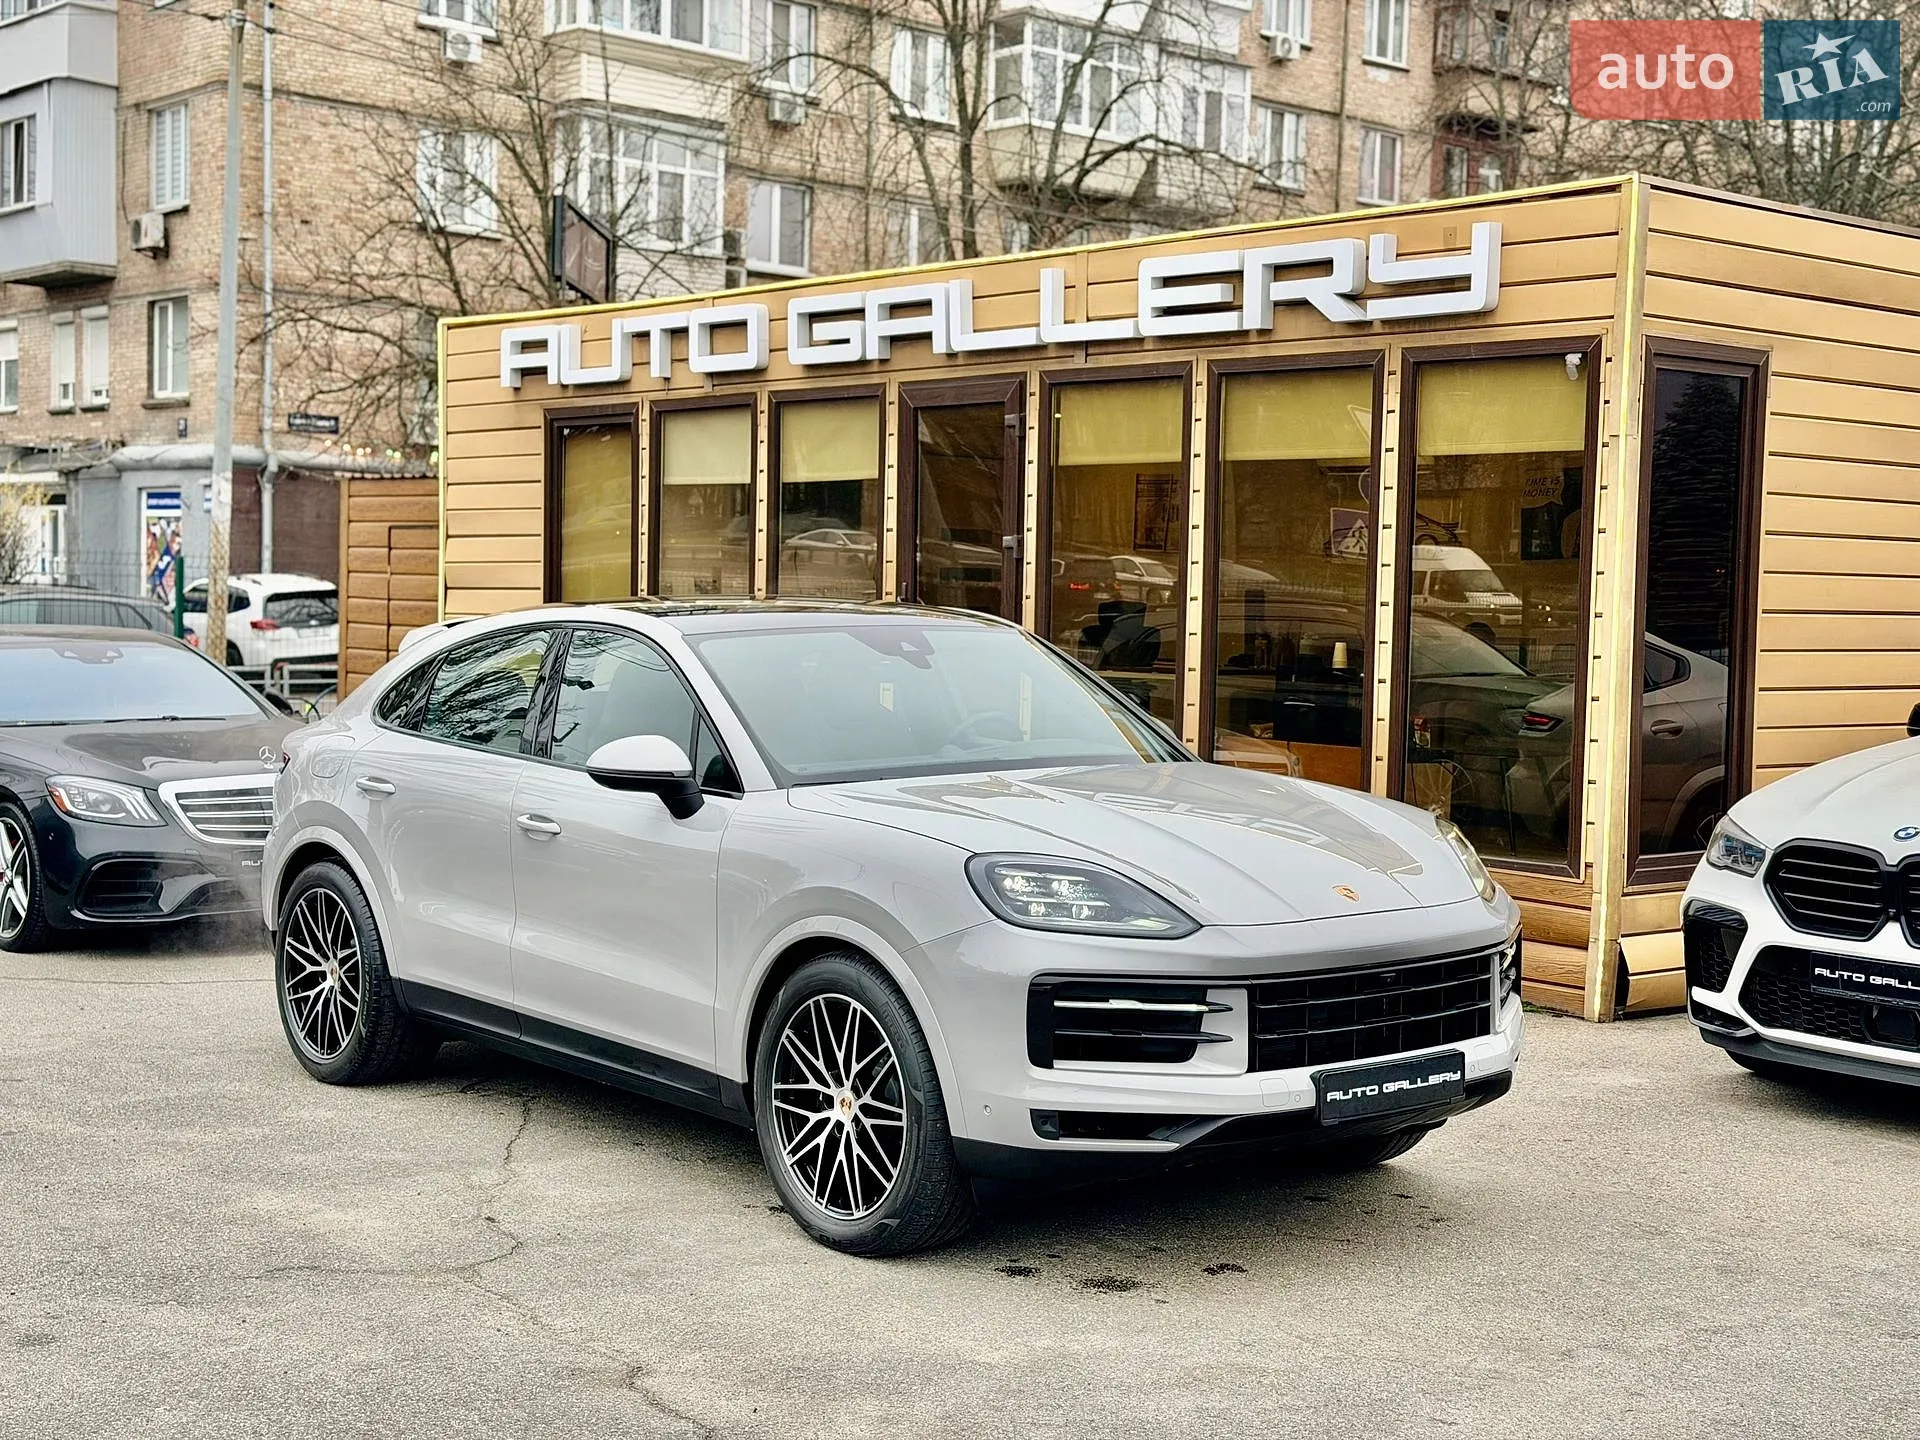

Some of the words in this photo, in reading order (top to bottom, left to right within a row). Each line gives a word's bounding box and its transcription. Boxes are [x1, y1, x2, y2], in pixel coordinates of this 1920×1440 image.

[500, 303, 769, 388] AUTO
[788, 222, 1502, 364] GALLERY
[1522, 487, 1559, 497] MONEY
[1814, 967, 1866, 982] AUTO
[1326, 1085, 1379, 1102] AUTO
[1382, 1070, 1461, 1093] GALLERY
